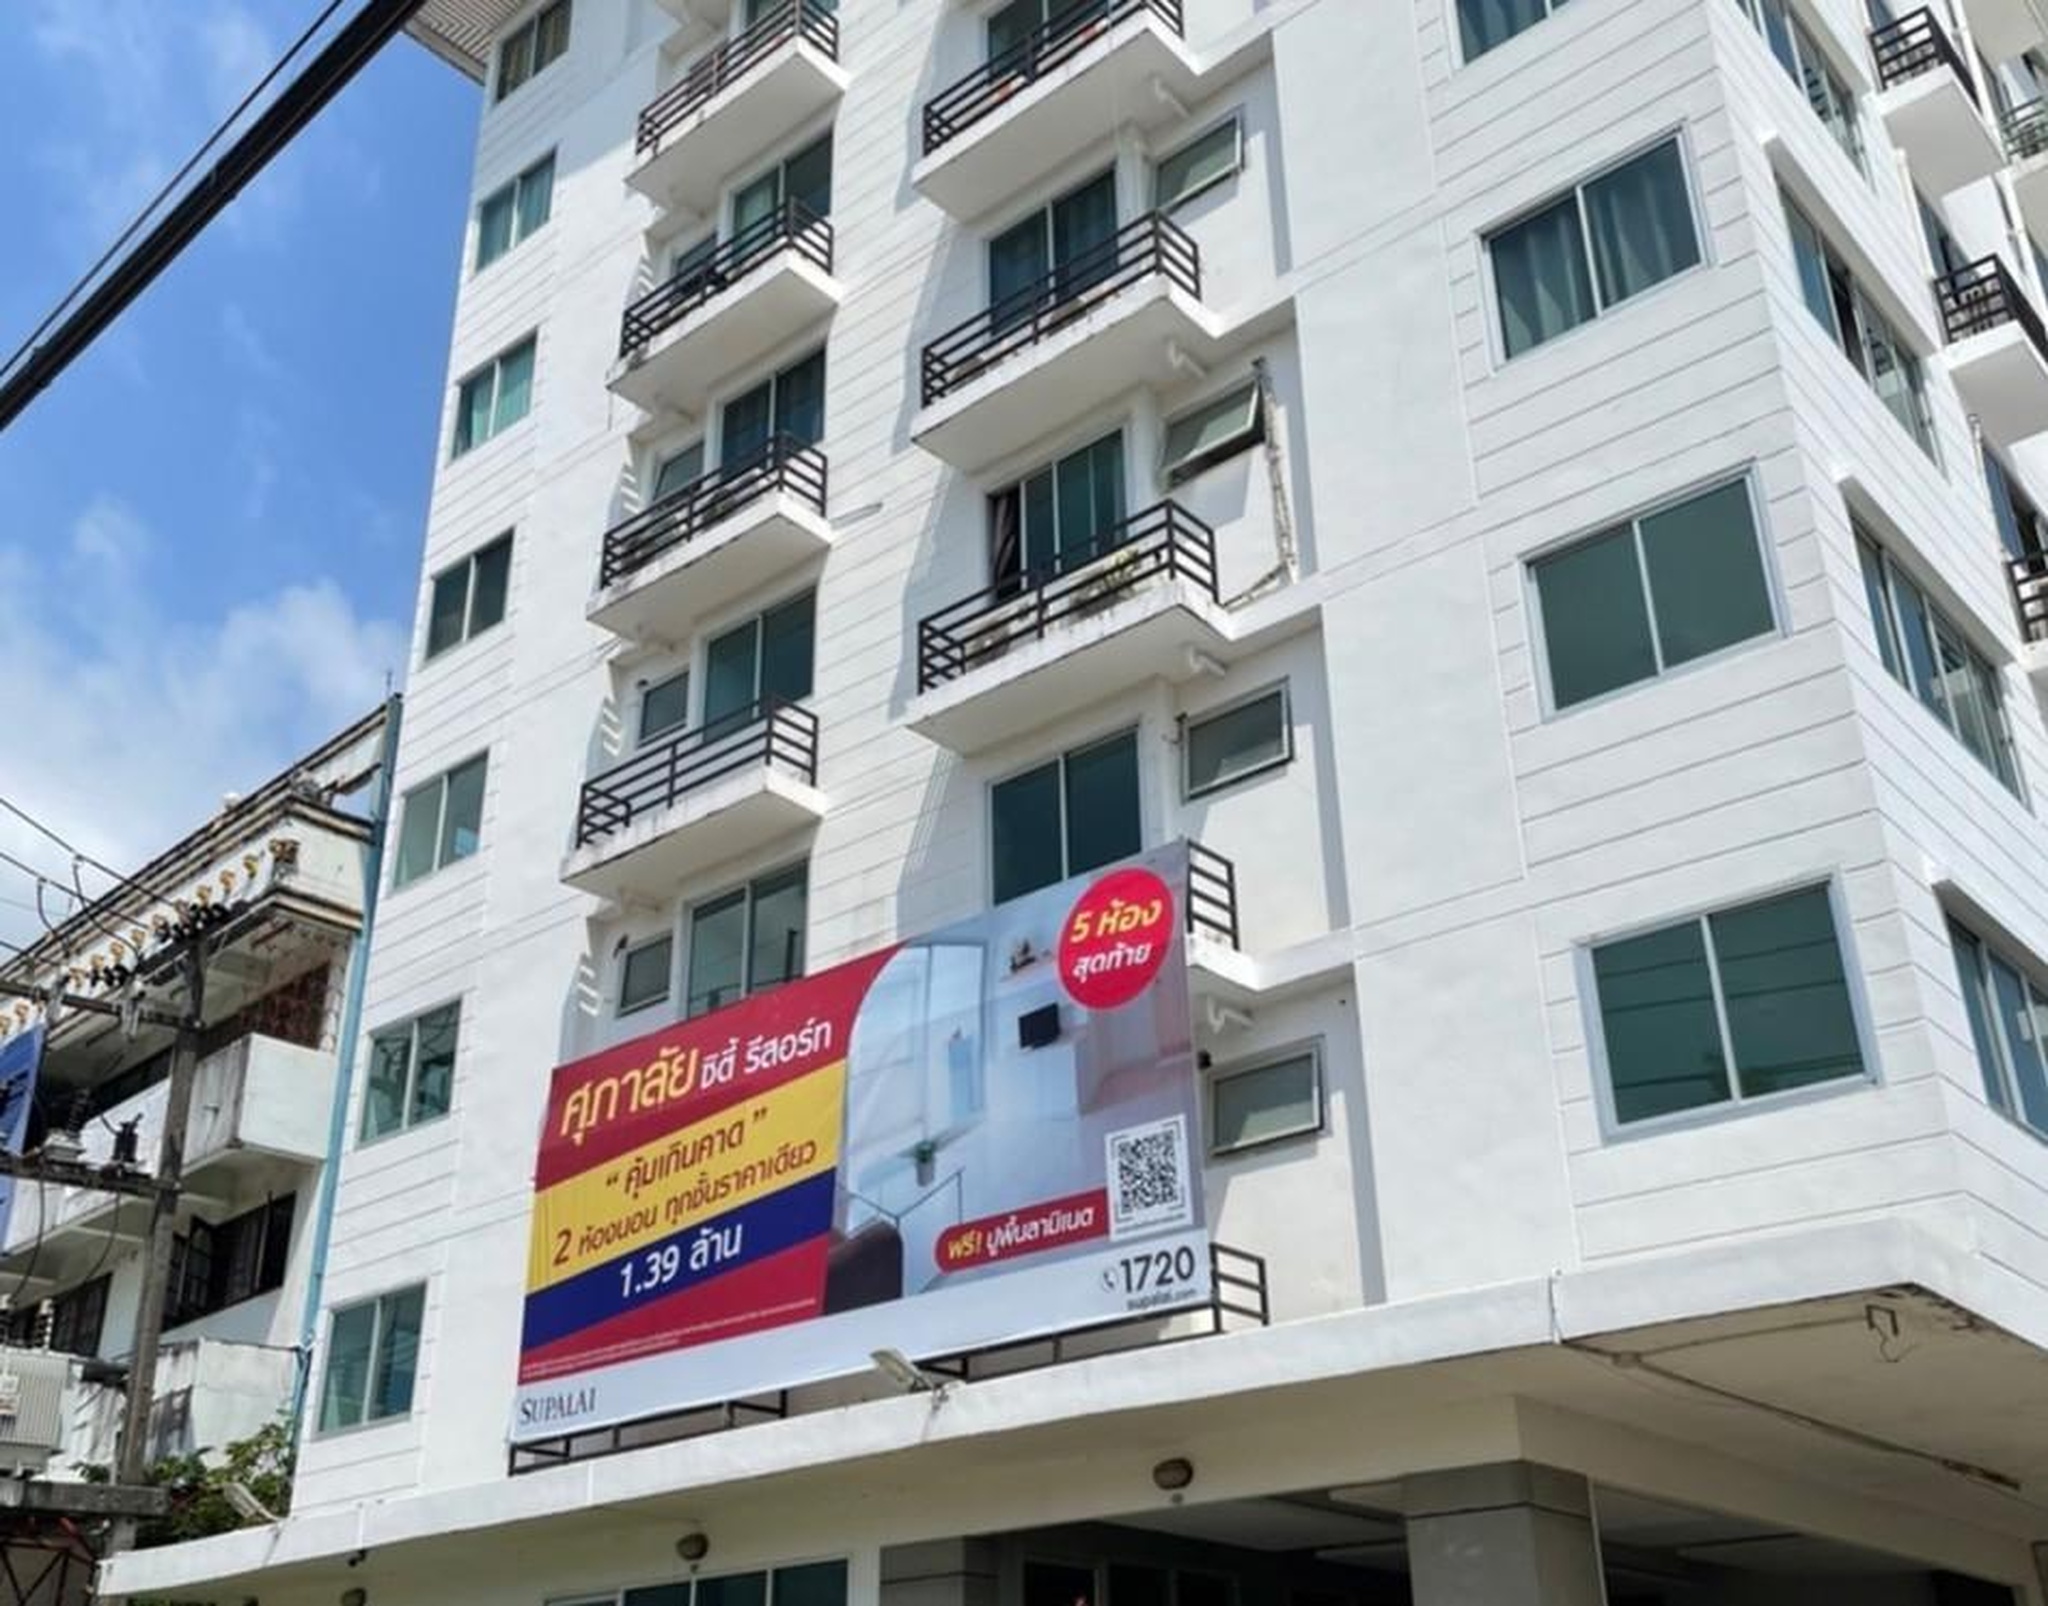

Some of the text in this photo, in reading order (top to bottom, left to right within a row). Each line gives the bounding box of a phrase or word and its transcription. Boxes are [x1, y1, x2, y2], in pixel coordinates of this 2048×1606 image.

[1070, 898, 1162, 943] 5 ห้อง
[1073, 942, 1152, 984] สุดท้าย
[560, 1017, 832, 1146] ศุภาลัย ซิตี้ รีสอร์ท
[624, 1120, 746, 1200] คุ้มเกินคาด
[553, 1228, 572, 1266] 2
[577, 1204, 658, 1257] ห้องนอน
[947, 1228, 983, 1261] ฟรี!
[620, 1222, 743, 1298] 1.39 ล้าน
[1120, 1246, 1195, 1293] 1720
[520, 1387, 597, 1425] SUPALAI
